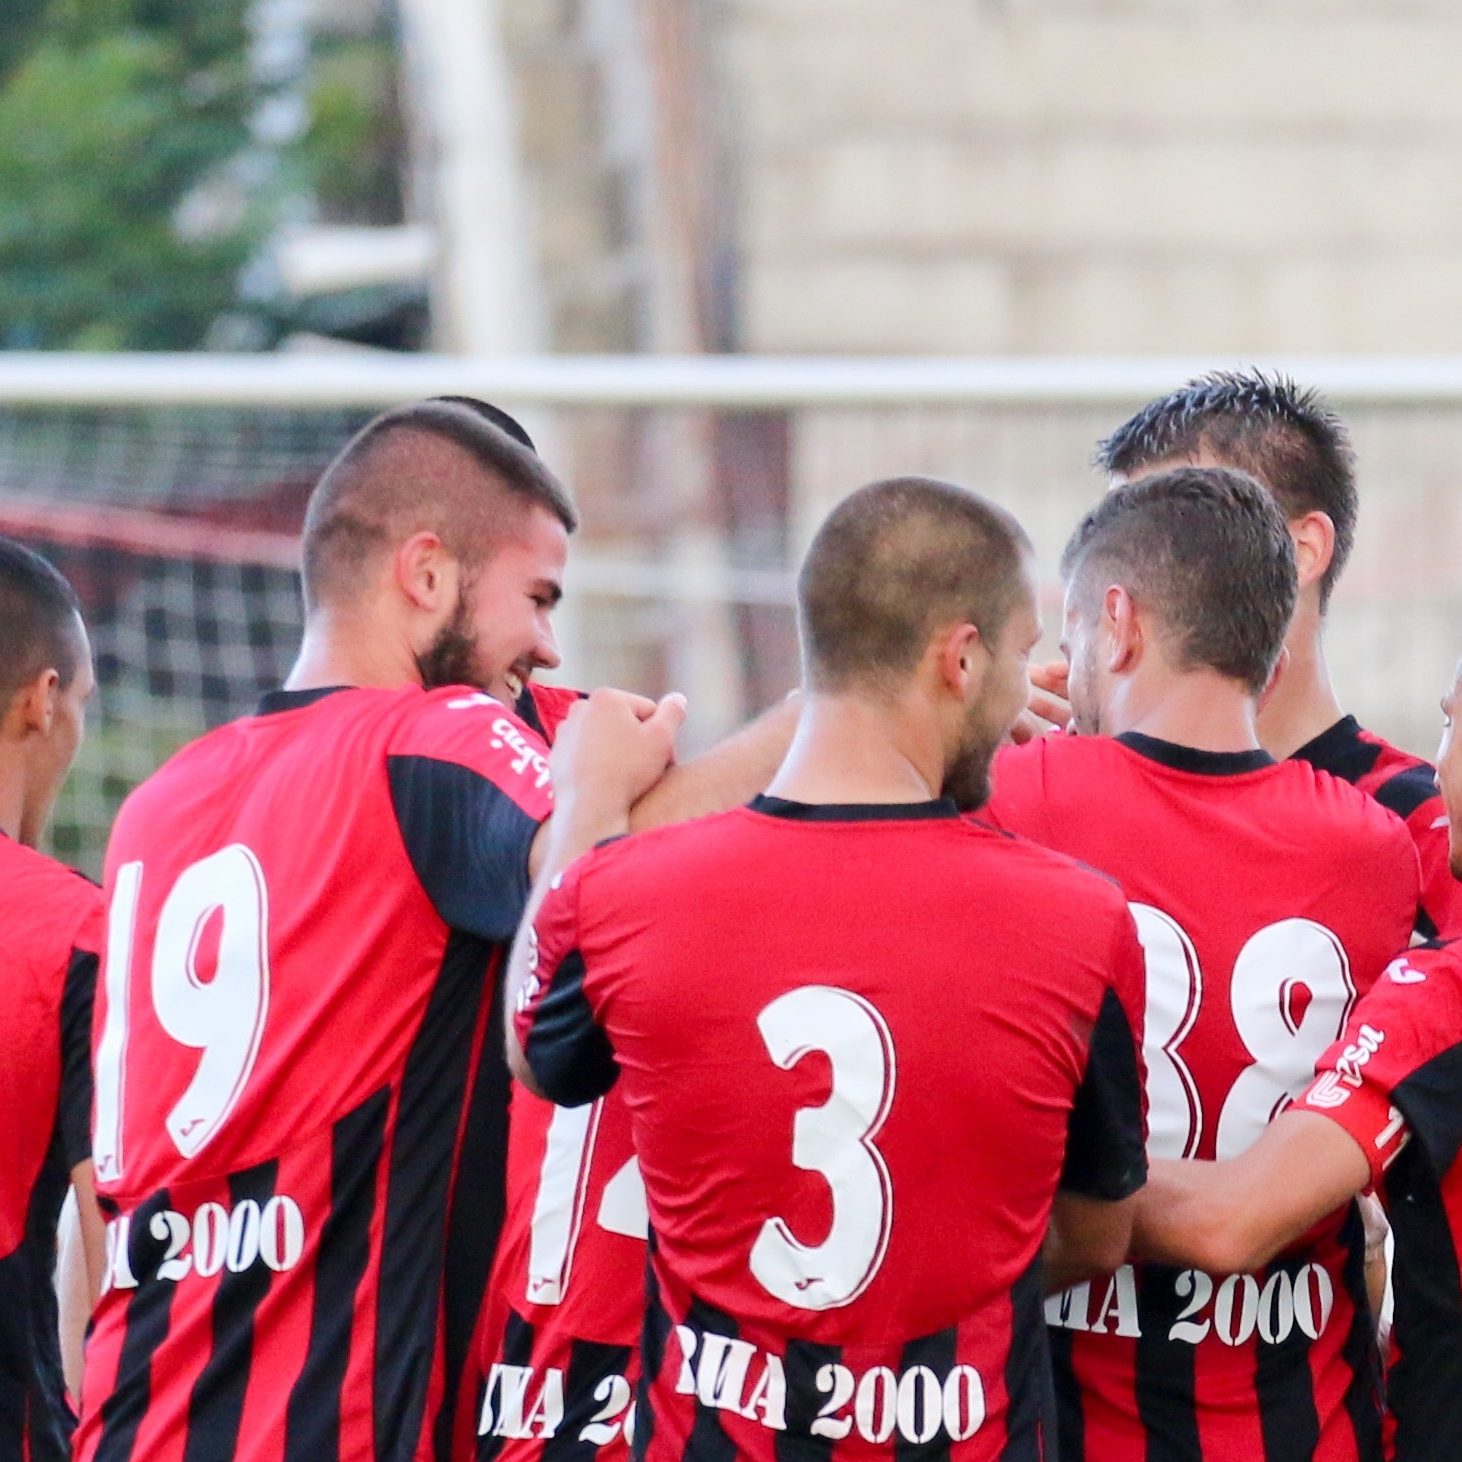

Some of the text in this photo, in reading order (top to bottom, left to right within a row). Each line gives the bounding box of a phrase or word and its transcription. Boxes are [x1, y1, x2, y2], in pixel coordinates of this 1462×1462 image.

[91, 842, 270, 1182] 19
[748, 984, 896, 1310] 3
[149, 1194, 305, 1281] 2000
[1043, 1262, 1334, 1347] ИА 2000
[810, 1363, 986, 1444] 2000
